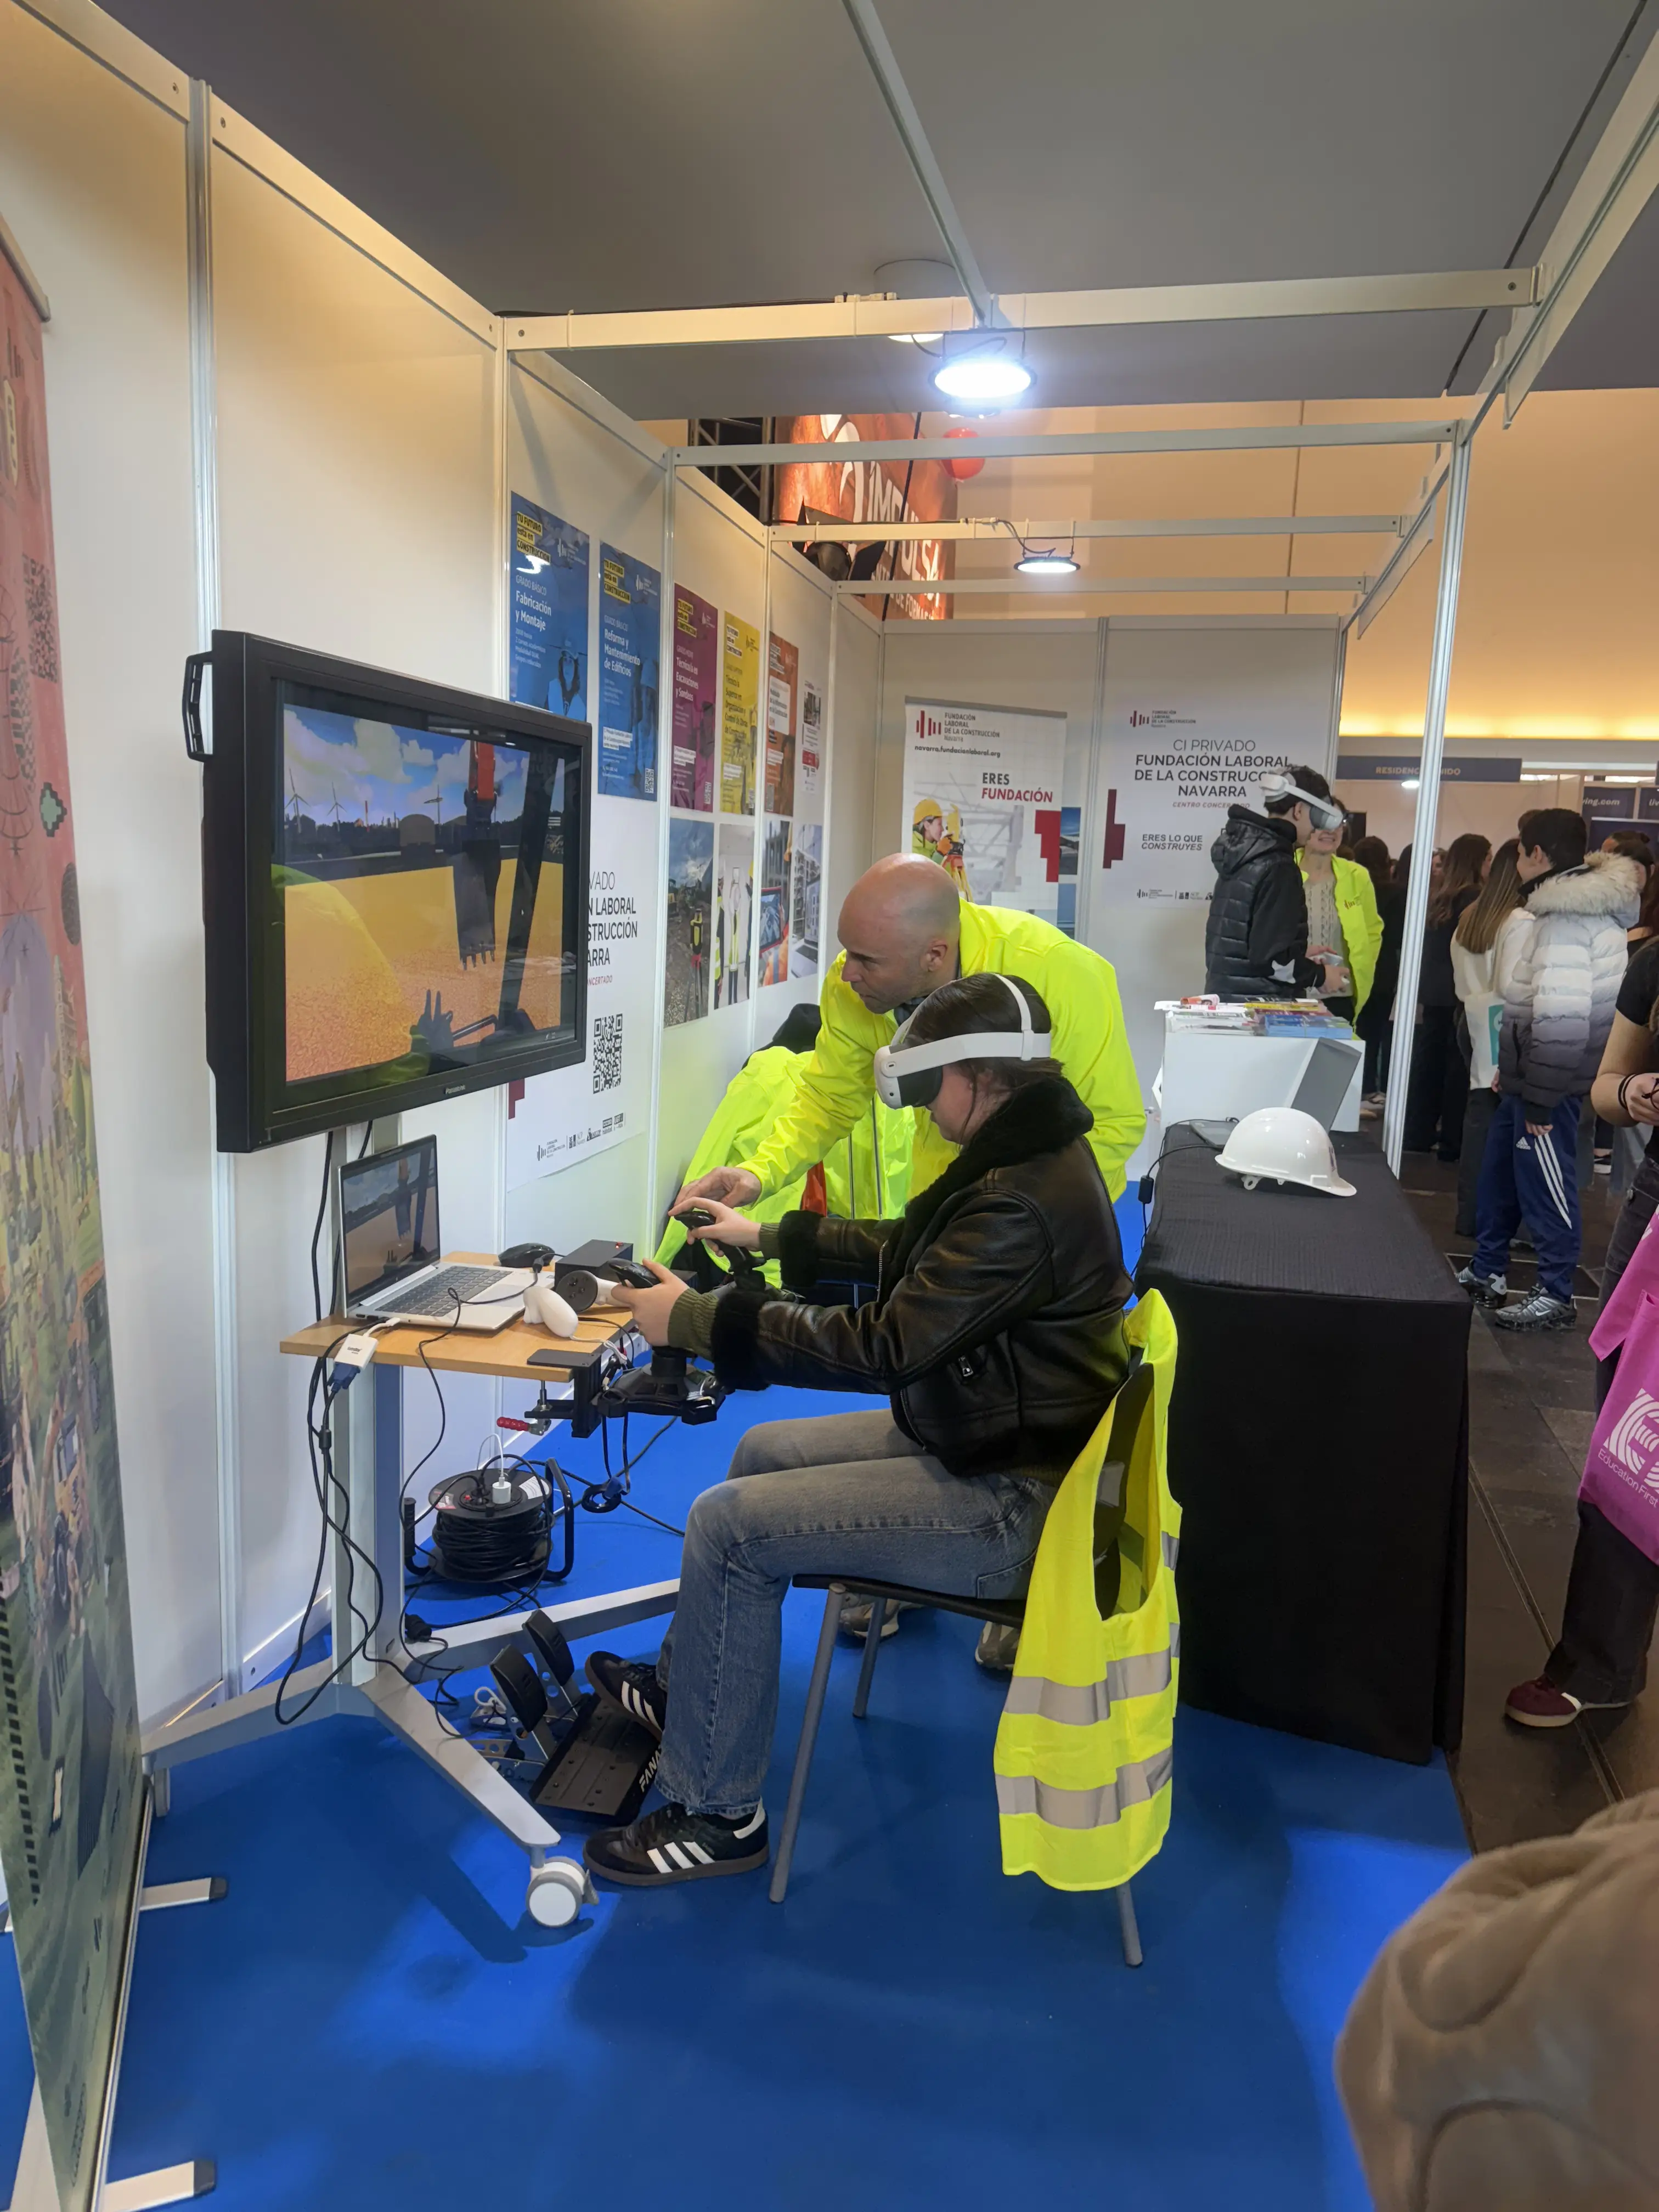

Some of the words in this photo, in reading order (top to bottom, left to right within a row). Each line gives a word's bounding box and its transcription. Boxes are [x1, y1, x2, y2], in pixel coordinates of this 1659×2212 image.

[517, 513, 523, 523] TU
[524, 516, 541, 533] FUTURO
[516, 574, 531, 589] GRADO
[516, 590, 551, 616] Fabricación
[516, 610, 520, 623] y
[521, 610, 546, 632] Montaje
[604, 629, 624, 646] Reforma
[625, 639, 629, 650] y
[604, 643, 640, 665] Mantenimiento
[604, 658, 611, 669] de
[612, 661, 631, 677] Edificios
[676, 672, 699, 690] Excavaciones
[945, 712, 975, 720] FUNDACIÓN
[961, 729, 1000, 738] CONSTRUCCIÓN
[915, 745, 1001, 758] navarra.fundacionlaboral.org
[1173, 739, 1186, 751] CI
[1191, 739, 1256, 752] PRIVADO
[1135, 753, 1221, 767] FUNDACIÓN
[1225, 755, 1289, 768] LABORAL
[1135, 769, 1153, 781] DE
[1156, 770, 1173, 781] LA
[1178, 770, 1267, 782] CONSTRUCC
[1376, 766, 1419, 775] RESIDENC
[982, 772, 1010, 786] ERES
[981, 787, 1053, 803] FUNDACIÓN
[1178, 785, 1247, 797] NAVARRA
[1142, 834, 1166, 843] ERES
[1169, 834, 1181, 843] LO
[1183, 834, 1203, 843] QUE
[1141, 843, 1202, 851] CONSTRUYES
[589, 871, 615, 890] VADO
[596, 897, 636, 916] LABORAL
[588, 916, 638, 942] STRUCCIÓN
[587, 947, 611, 967] ARRA
[587, 974, 613, 986] NCERTADO
[1598, 1448, 1640, 1491] Education
[1638, 1485, 1659, 1508] First
[639, 1745, 662, 1793] FANA
